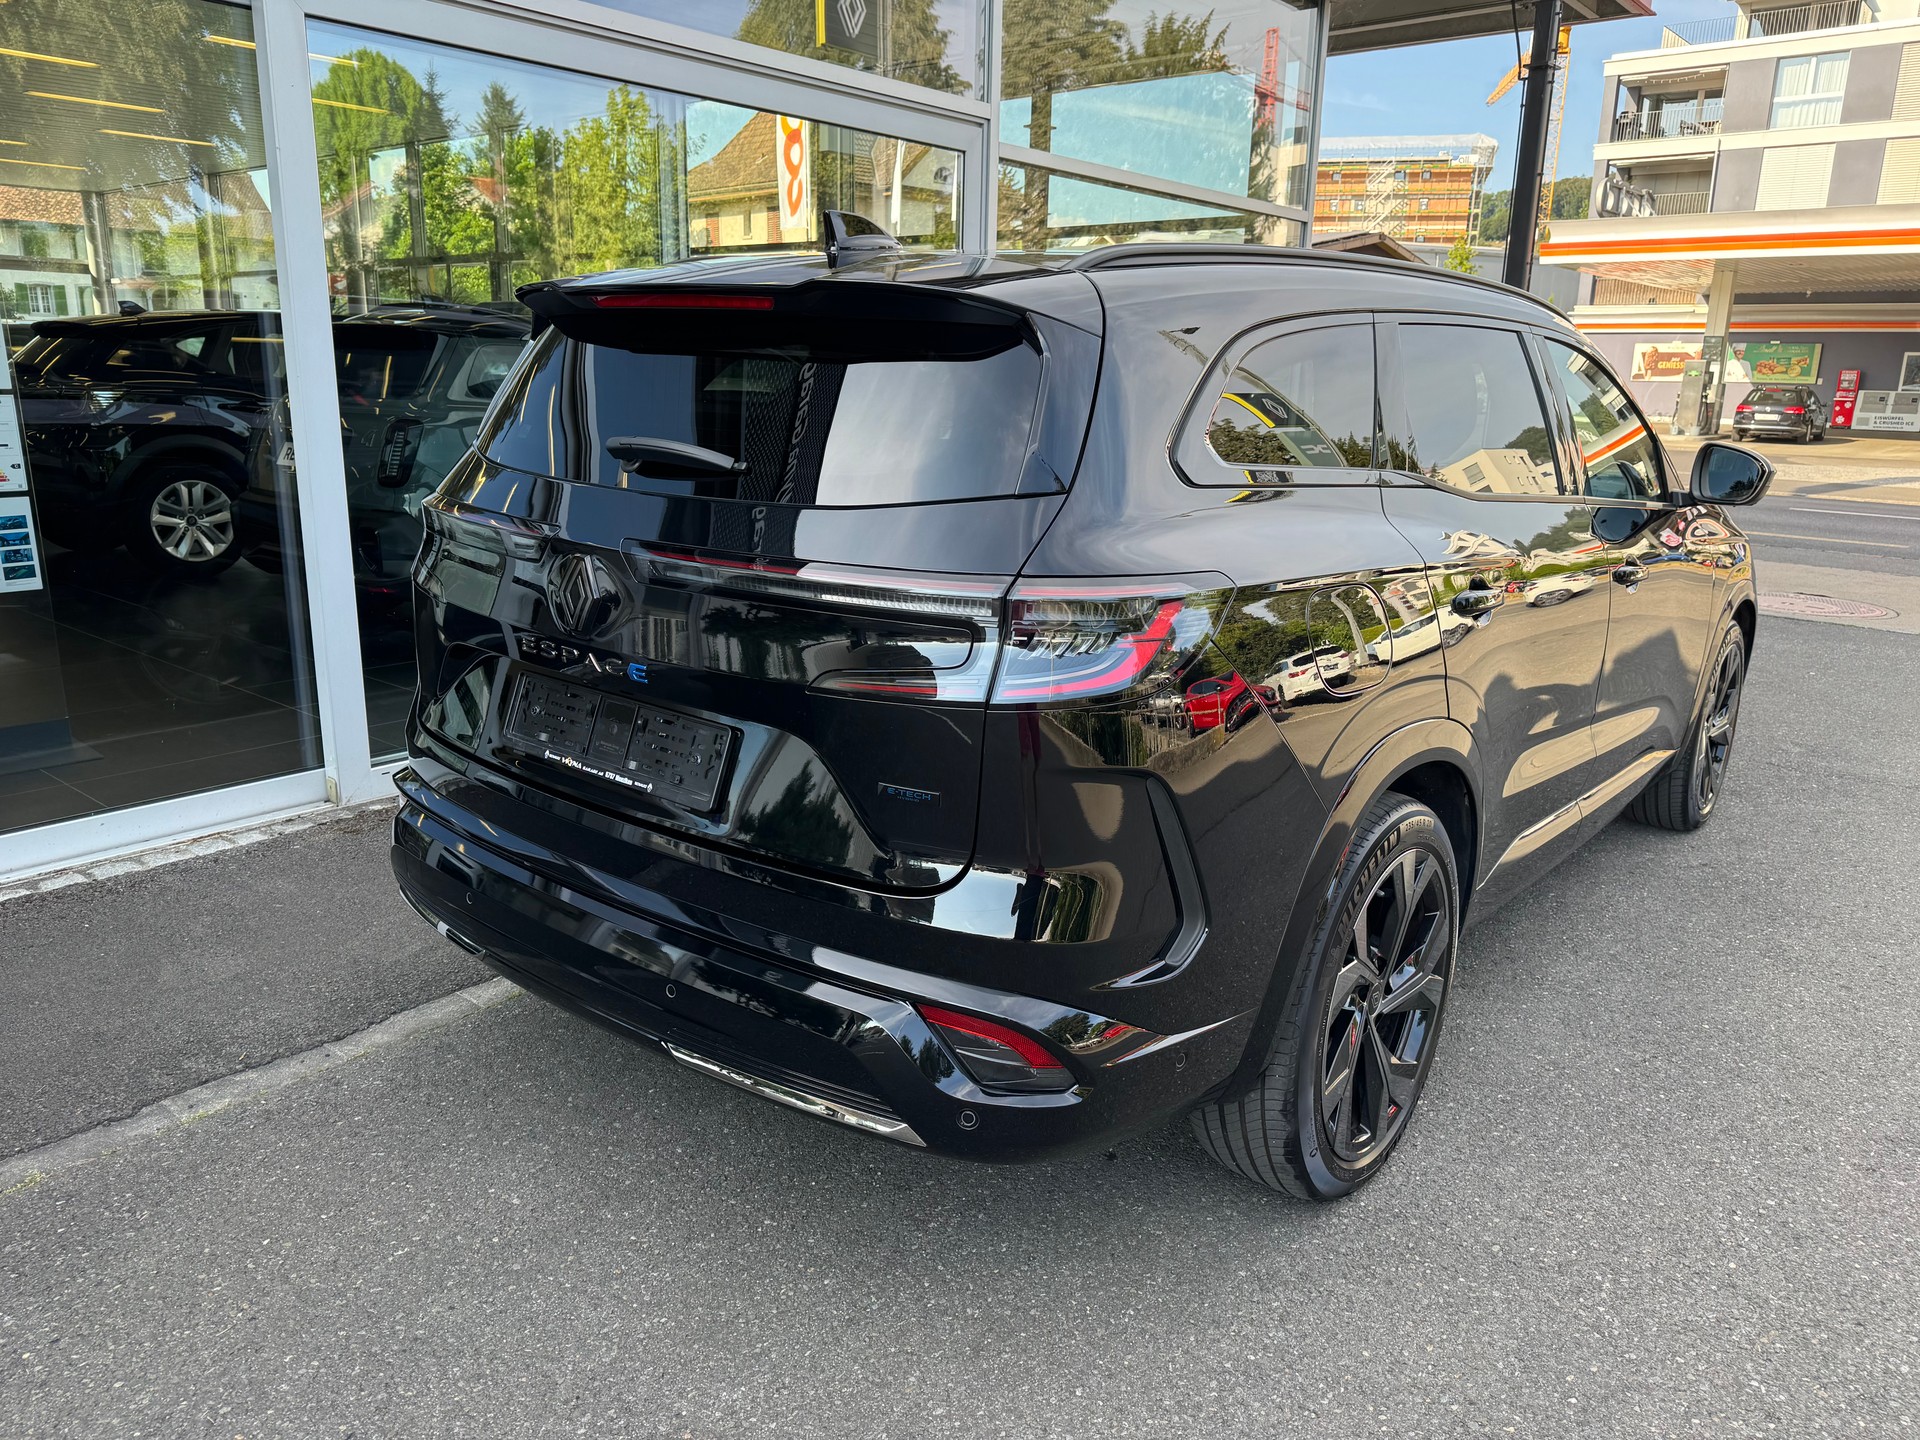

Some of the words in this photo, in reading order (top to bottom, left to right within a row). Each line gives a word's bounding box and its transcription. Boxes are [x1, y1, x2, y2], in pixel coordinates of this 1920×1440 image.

[1657, 360, 1686, 370] GENIESS
[521, 637, 648, 684] ESPACE
[887, 787, 932, 800] E-TECH
[1338, 829, 1399, 941] MICHELIN
